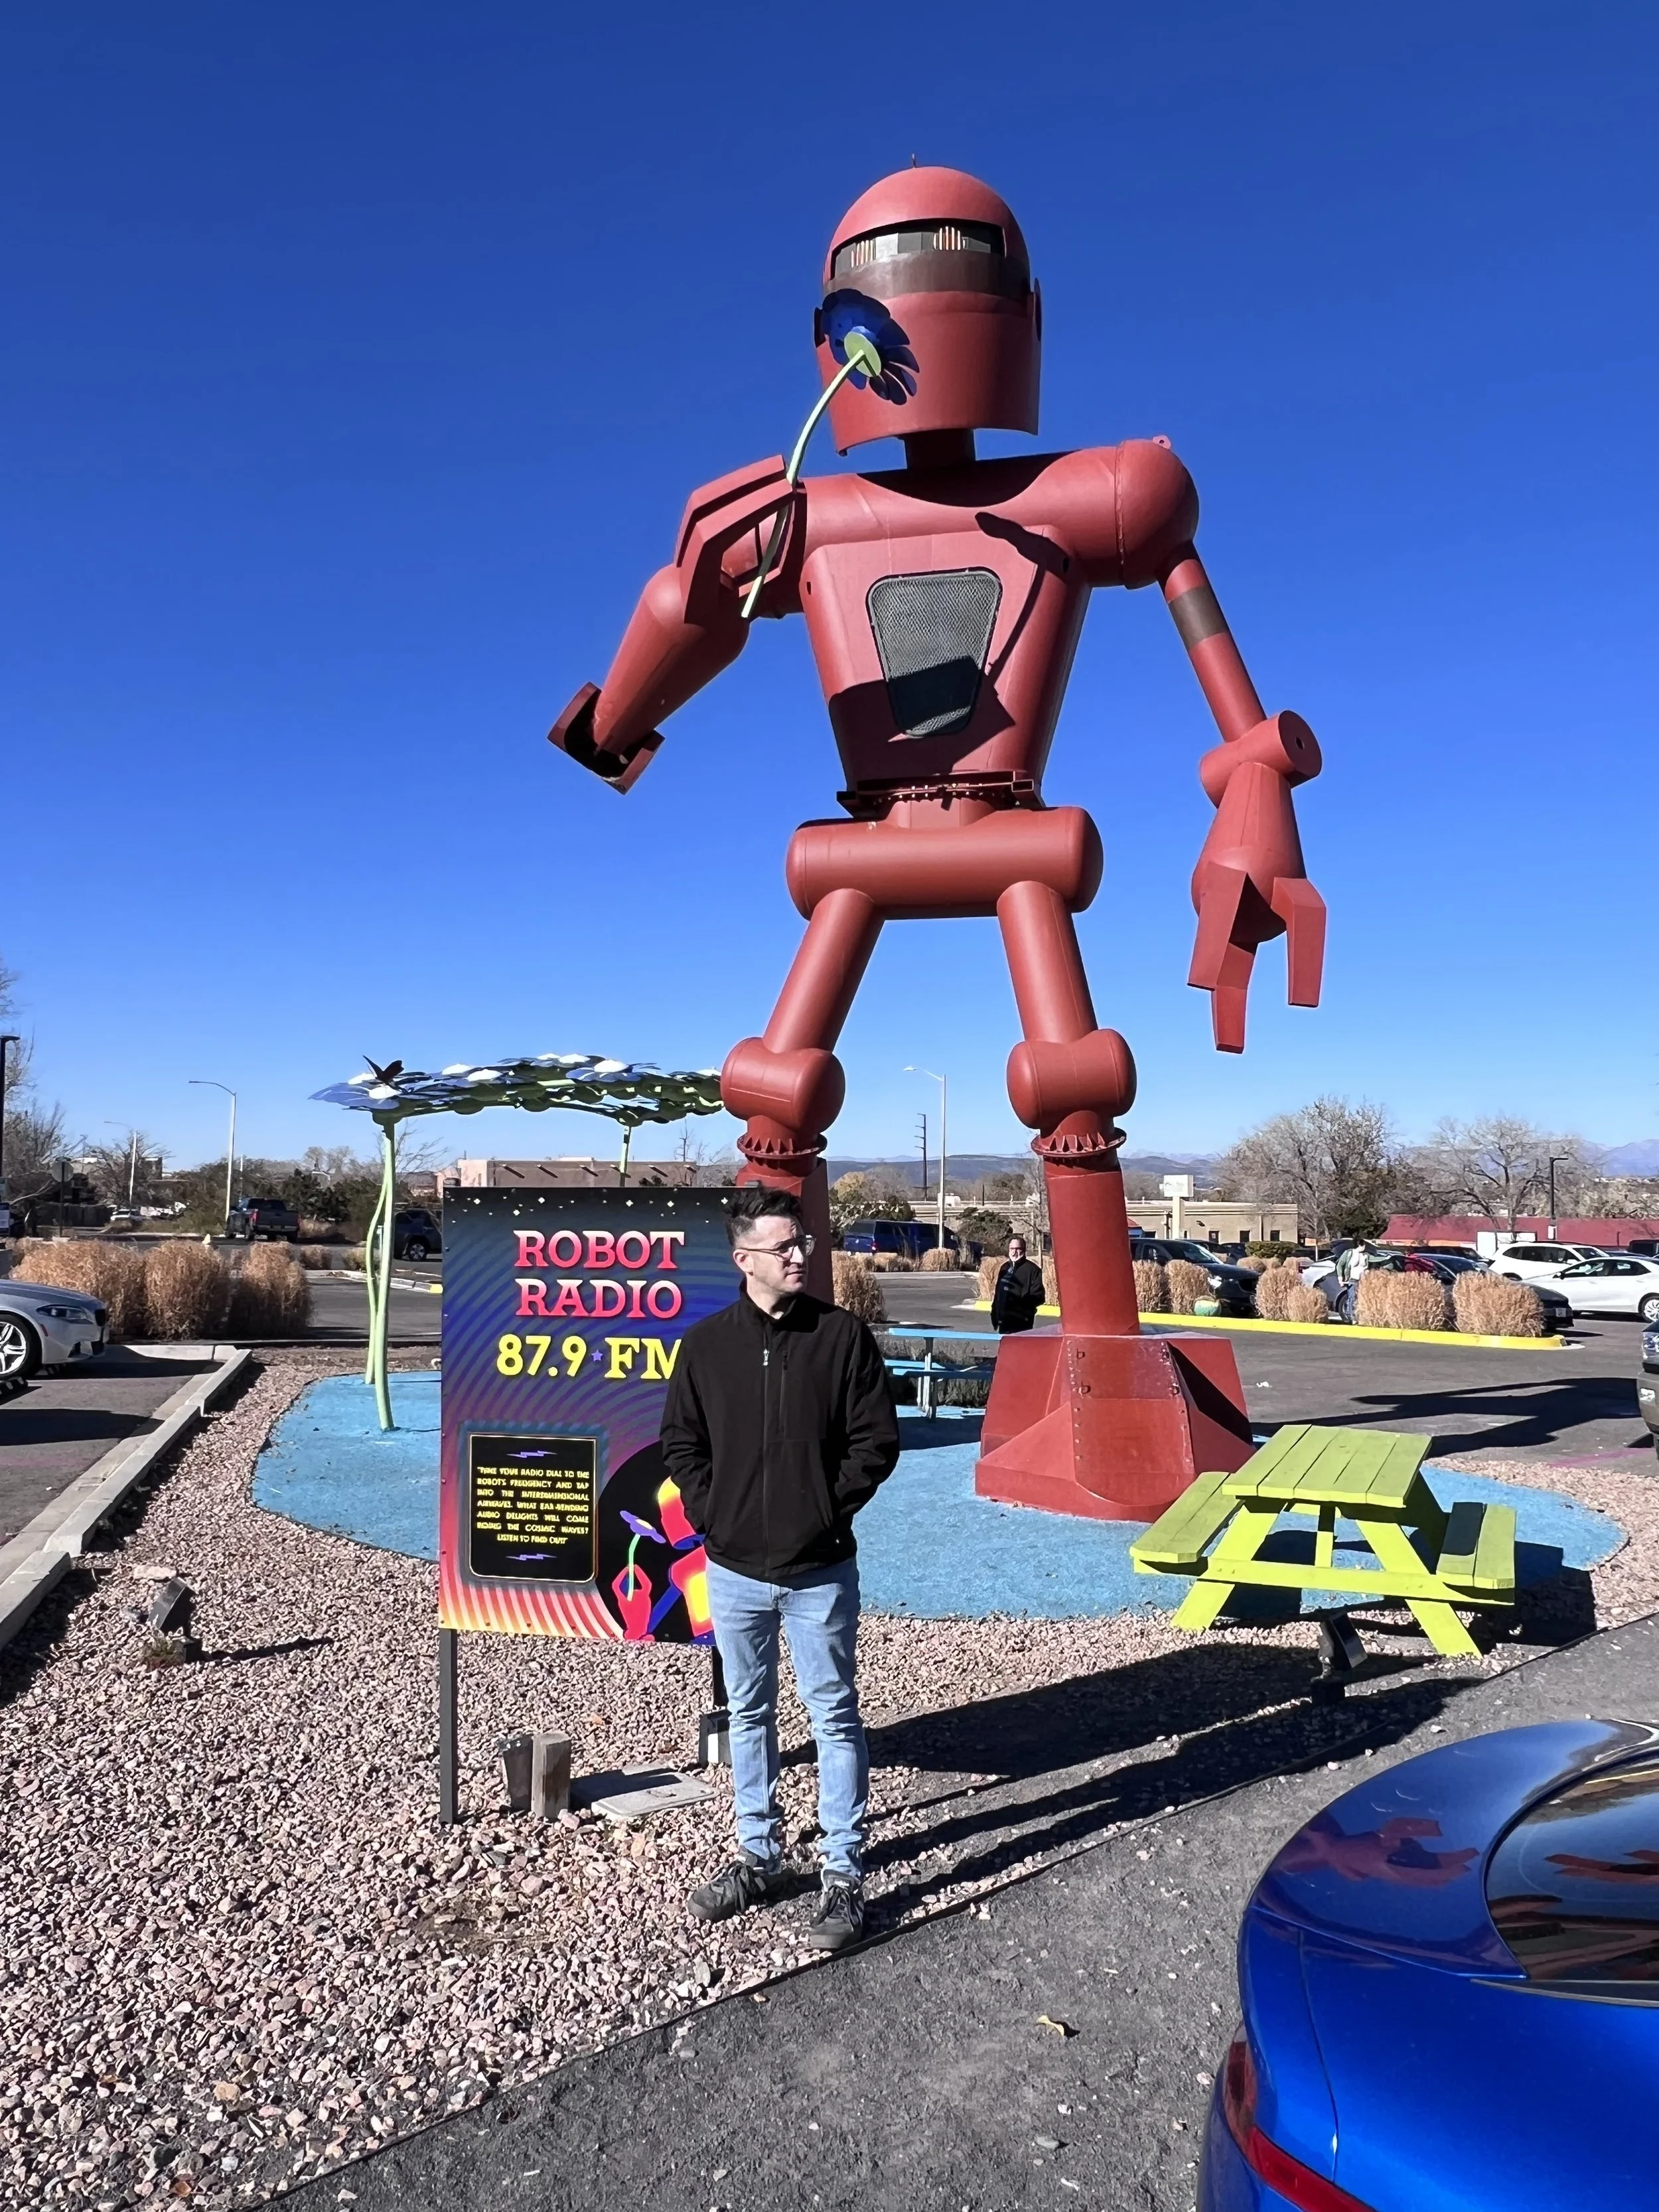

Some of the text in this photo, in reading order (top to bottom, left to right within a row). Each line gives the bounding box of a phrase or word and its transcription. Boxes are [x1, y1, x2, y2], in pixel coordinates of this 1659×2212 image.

[514, 1230, 684, 1269] ROBOT
[515, 1278, 682, 1318] RADIO
[496, 1333, 682, 1379] 87.9 FM
[506, 1512, 538, 1520] DELIGHTS
